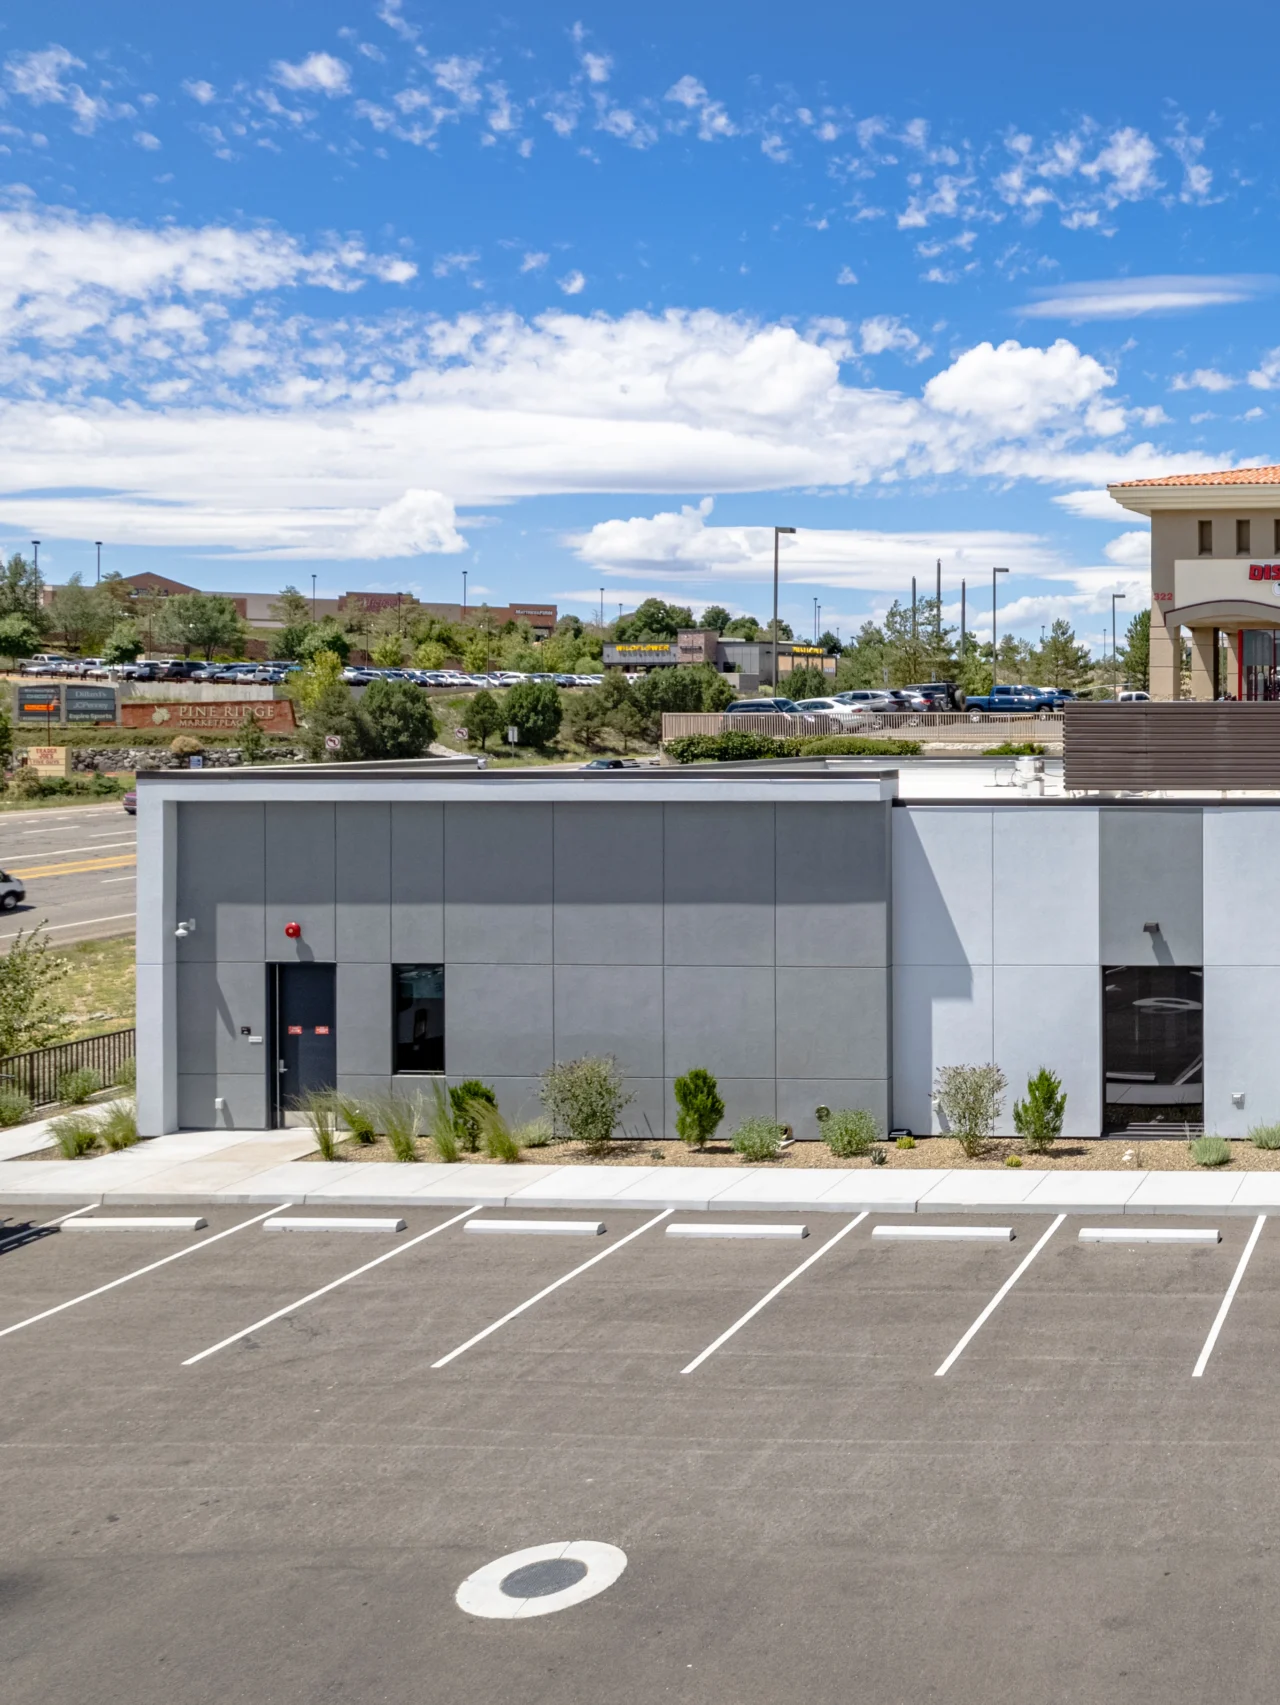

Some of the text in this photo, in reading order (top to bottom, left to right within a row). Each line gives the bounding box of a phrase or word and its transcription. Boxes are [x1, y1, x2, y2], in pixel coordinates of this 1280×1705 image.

[1154, 592, 1173, 600] 322
[75, 690, 107, 698] Dillard's
[73, 701, 108, 709] JCPenney
[179, 705, 274, 717] PINE RIDGE
